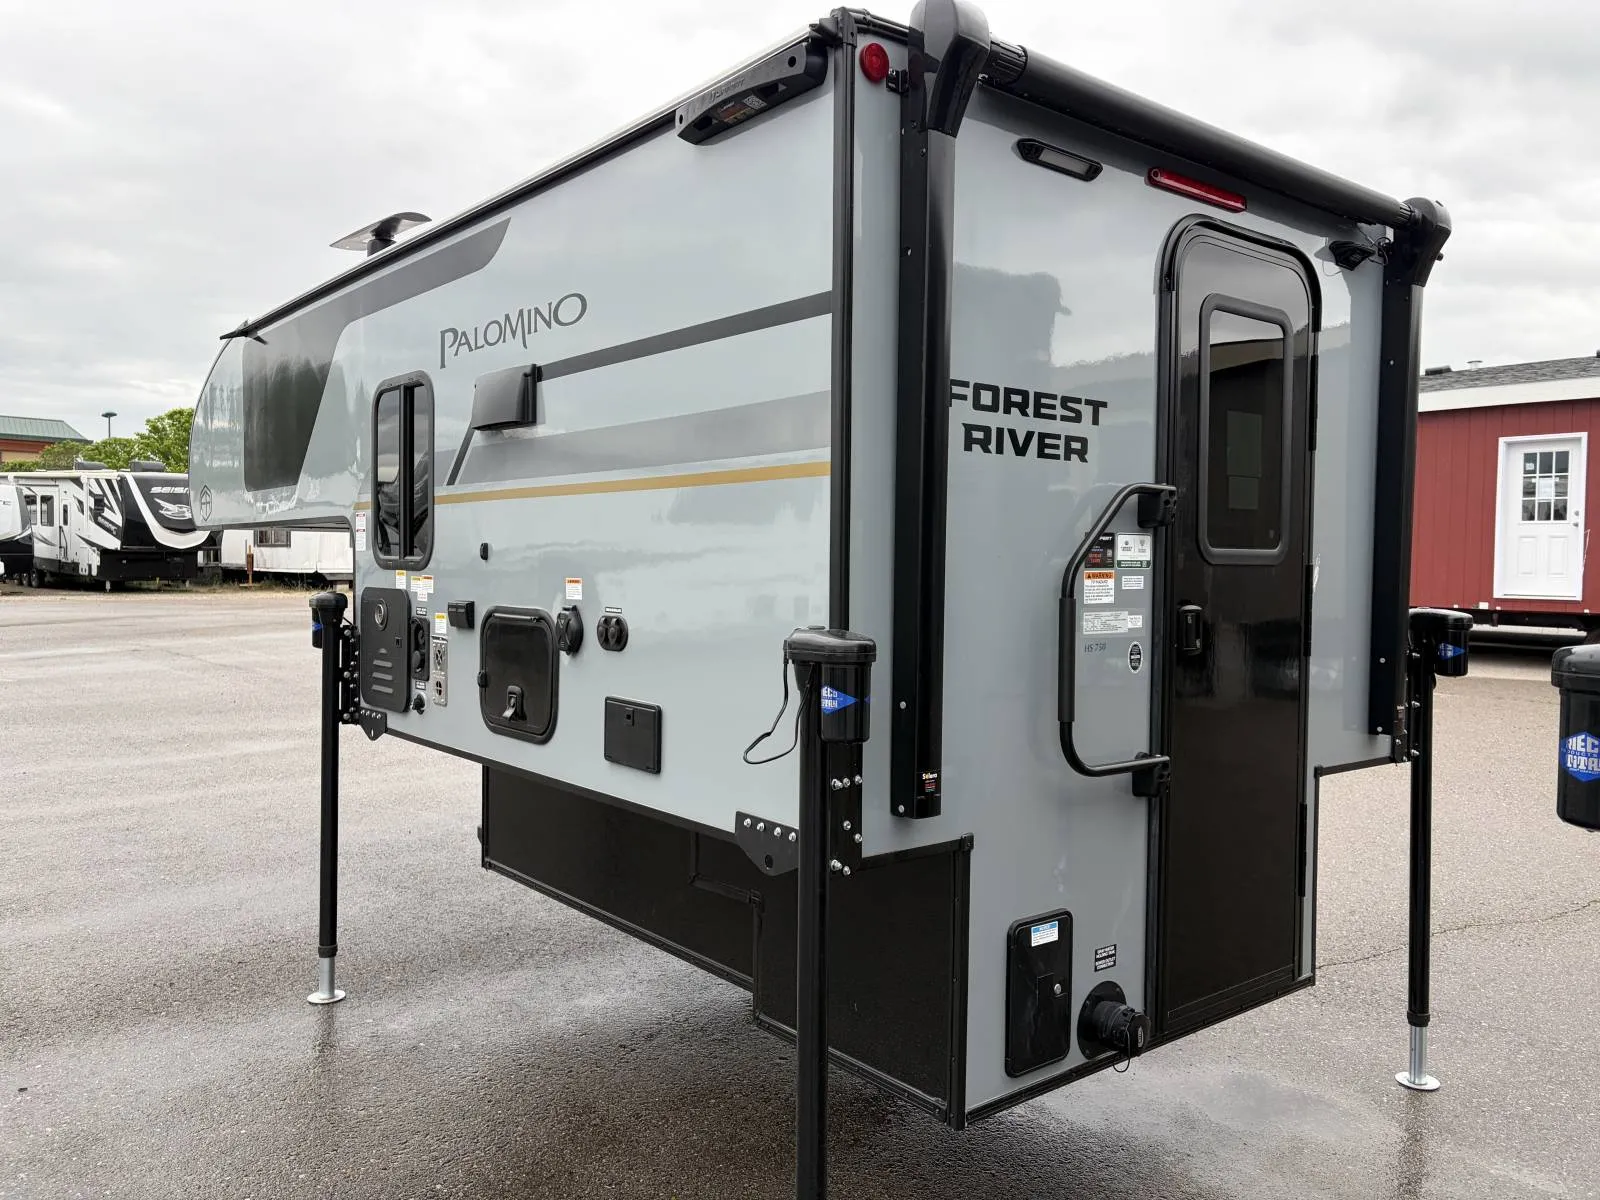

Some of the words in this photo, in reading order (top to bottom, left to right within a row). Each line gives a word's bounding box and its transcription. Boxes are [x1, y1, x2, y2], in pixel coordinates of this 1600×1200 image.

[440, 293, 587, 369] PALOMINO
[949, 379, 1108, 426] FOREST
[961, 422, 1088, 463] RIVER
